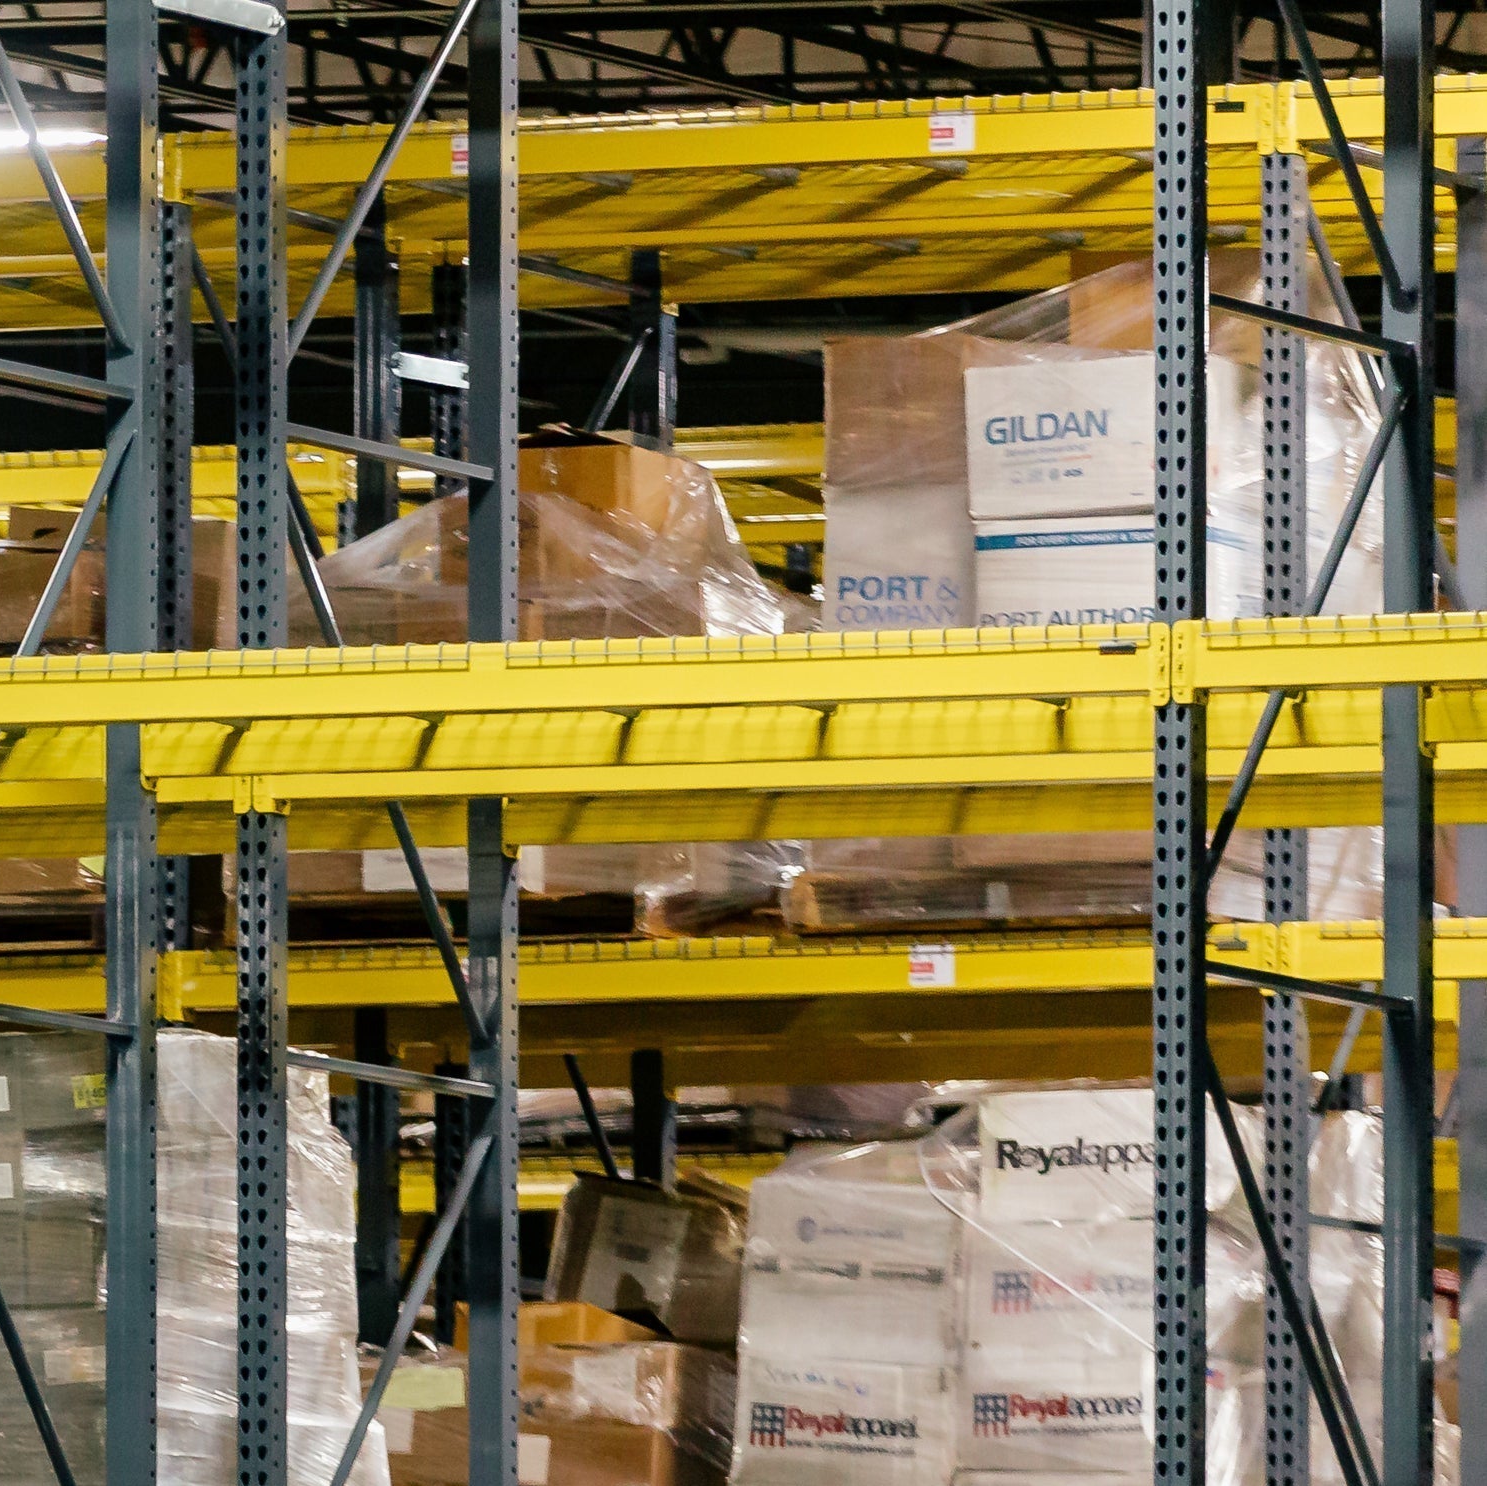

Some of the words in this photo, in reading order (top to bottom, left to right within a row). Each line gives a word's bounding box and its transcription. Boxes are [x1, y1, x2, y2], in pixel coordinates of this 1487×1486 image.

[984, 410, 1109, 446] GILDAN
[837, 575, 929, 601] PORT
[937, 577, 959, 600] &
[835, 604, 959, 628] COMPANY
[979, 611, 1036, 628] PORT
